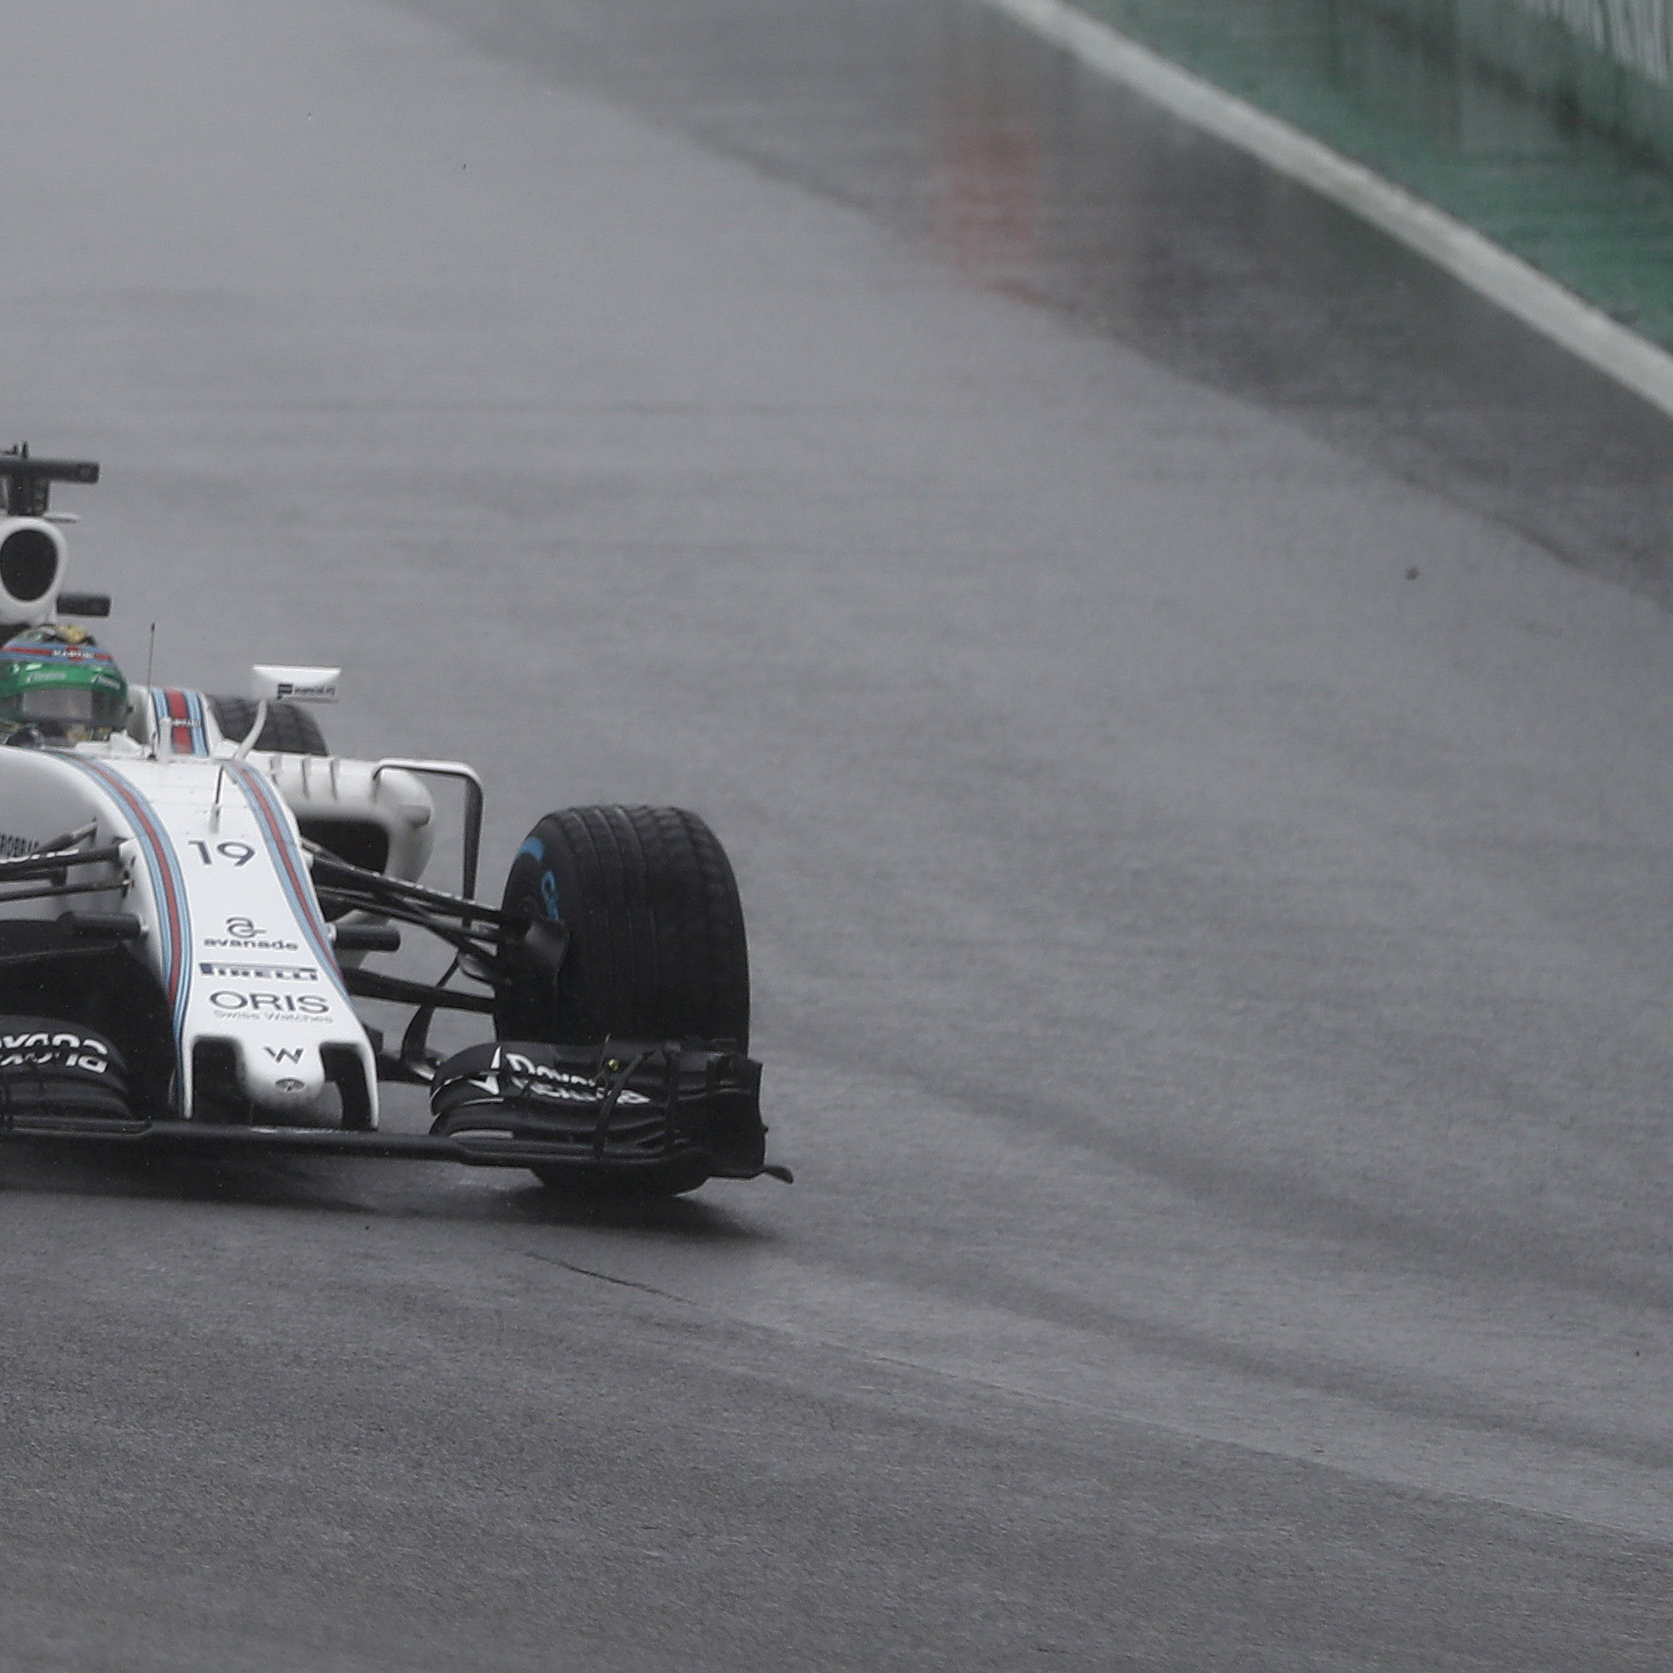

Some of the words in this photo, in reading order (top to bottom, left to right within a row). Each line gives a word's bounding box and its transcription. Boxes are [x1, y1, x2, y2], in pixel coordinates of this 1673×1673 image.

[188, 840, 255, 867] 19
[204, 938, 299, 951] avanade
[199, 962, 319, 981] PIRELLI
[209, 990, 330, 1014] ORIS
